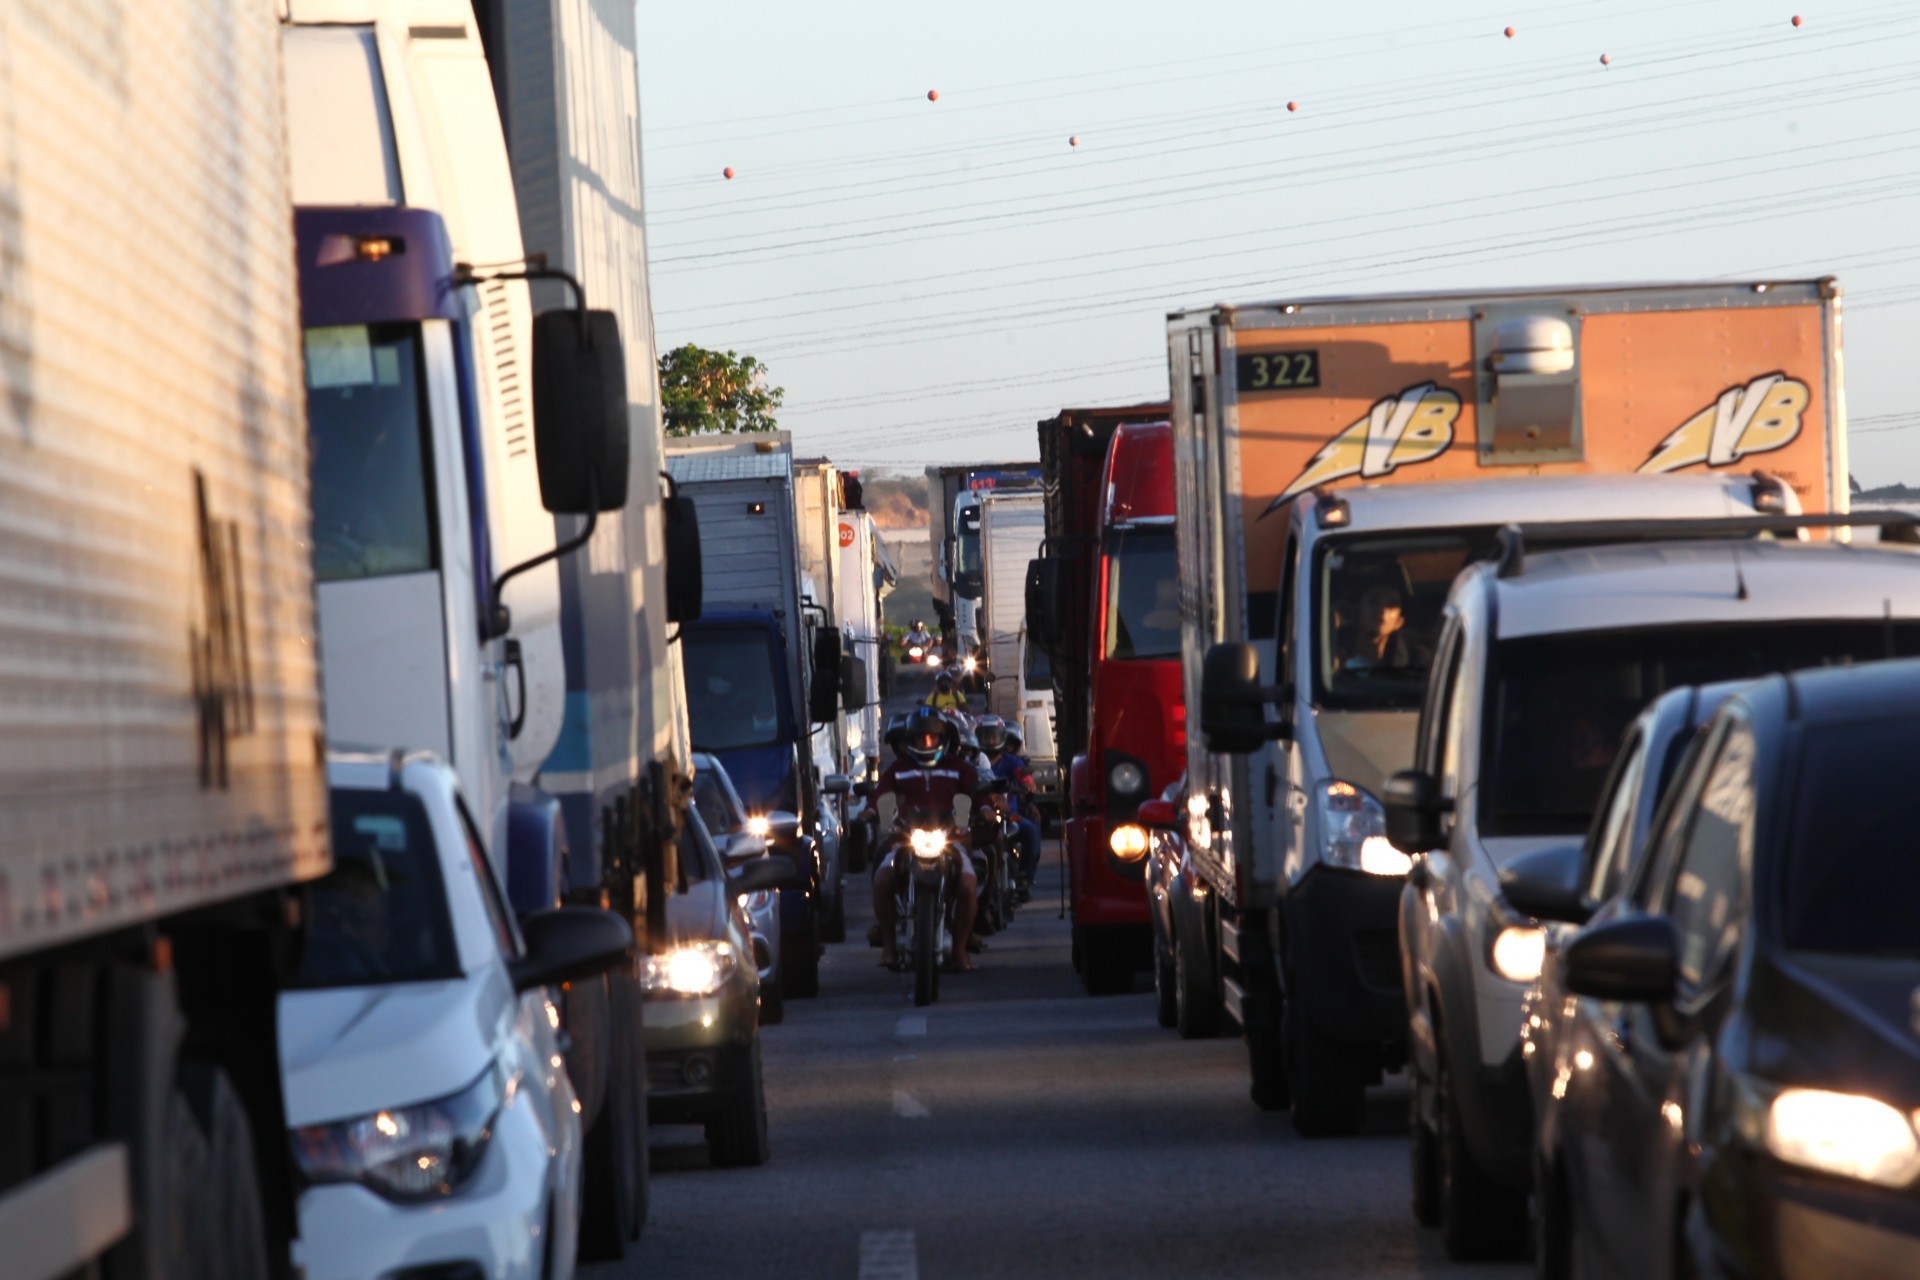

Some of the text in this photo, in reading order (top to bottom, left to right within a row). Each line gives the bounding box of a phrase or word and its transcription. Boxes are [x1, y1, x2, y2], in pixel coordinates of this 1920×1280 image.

[1251, 354, 1315, 387] 322
[1361, 381, 1461, 478] VB
[1708, 370, 1811, 468] VB
[840, 530, 854, 540] 02
